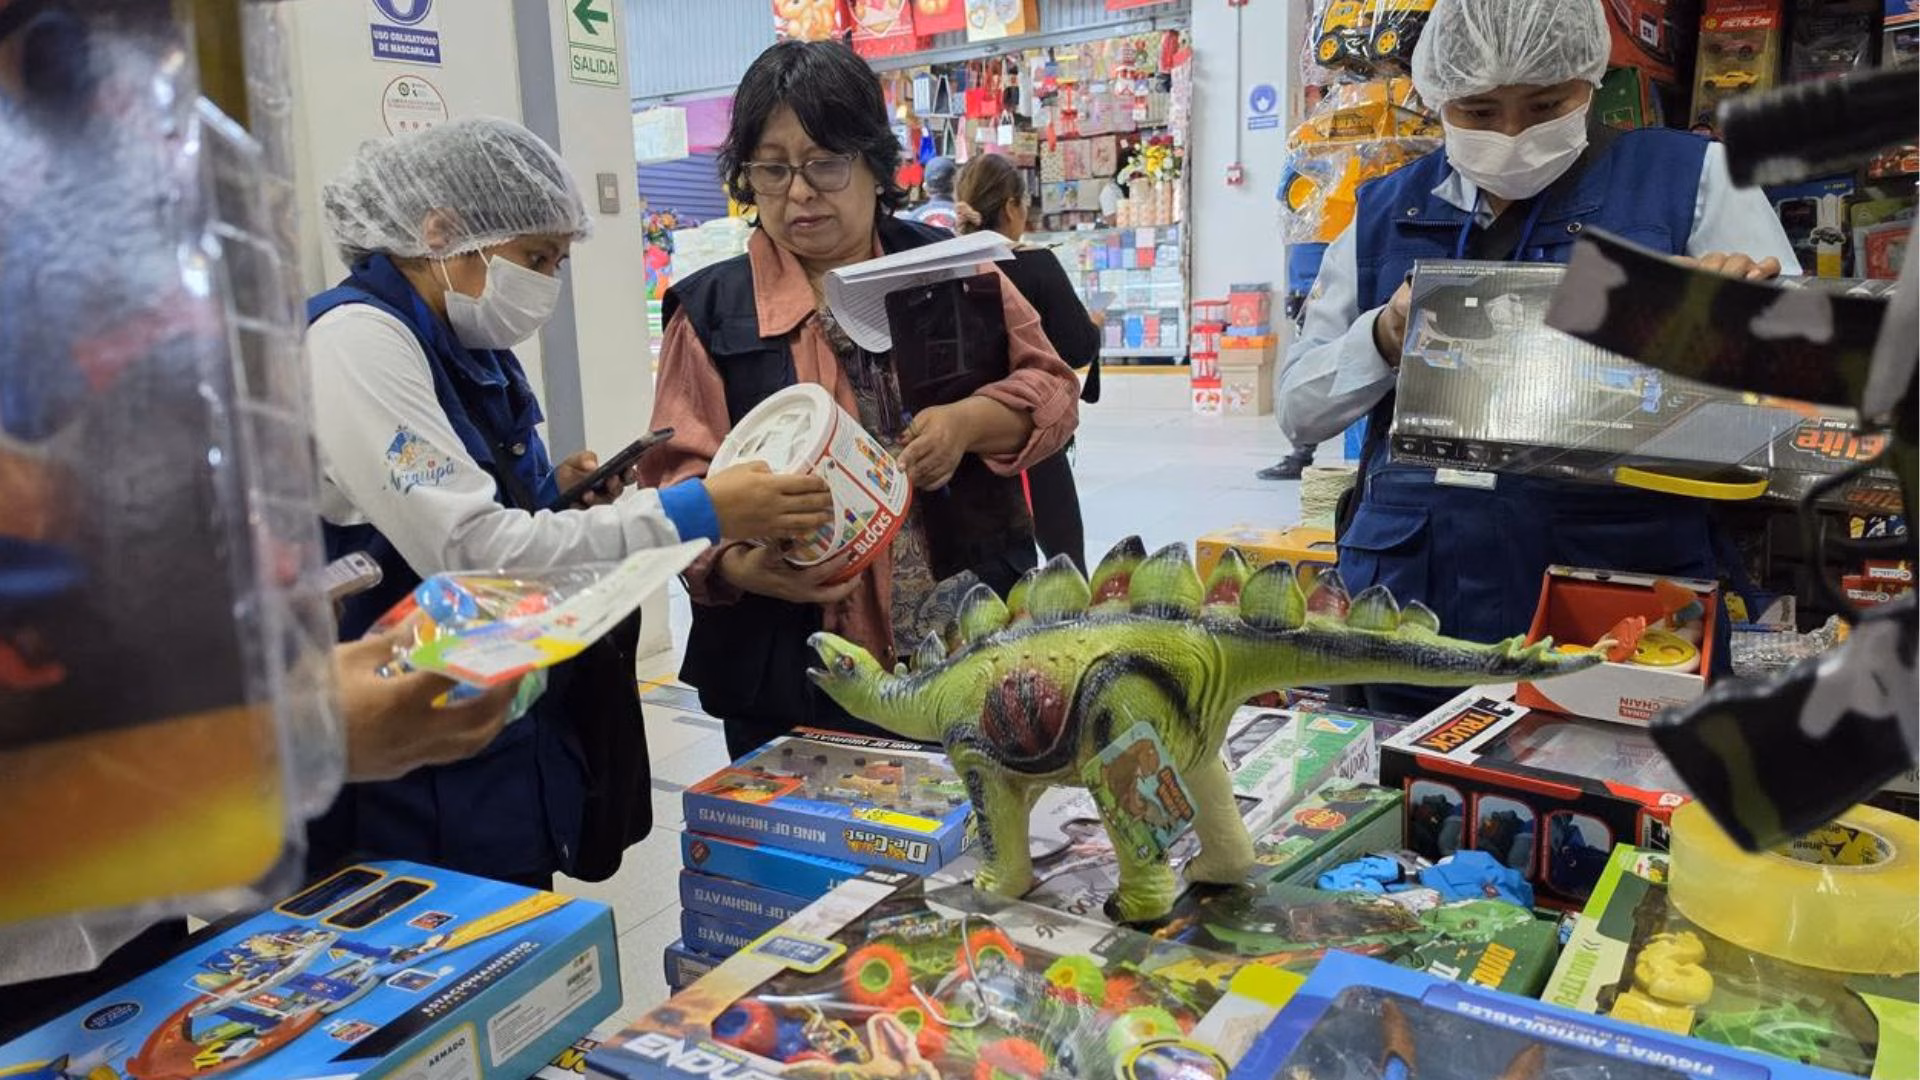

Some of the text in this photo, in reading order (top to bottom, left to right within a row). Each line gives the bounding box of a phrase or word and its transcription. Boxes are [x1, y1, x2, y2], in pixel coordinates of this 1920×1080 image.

[373, 30, 438, 47] USO OBLIGATORIO
[378, 42, 435, 57] DE MASCARILLA
[573, 54, 616, 75] SALIDA
[853, 512, 893, 554] BLOCKS
[1620, 696, 1660, 712] CHAIN
[1422, 712, 1498, 752] TRUCK
[699, 808, 826, 844] KING OF HIGHWAYS
[848, 829, 929, 863] Die-Cast
[694, 889, 763, 915] HIGHWAYS
[1457, 1001, 1608, 1049] ARTICULABLES
[428, 1037, 466, 1067] ARMADO
[1616, 1041, 1714, 1075] FIGURAS
